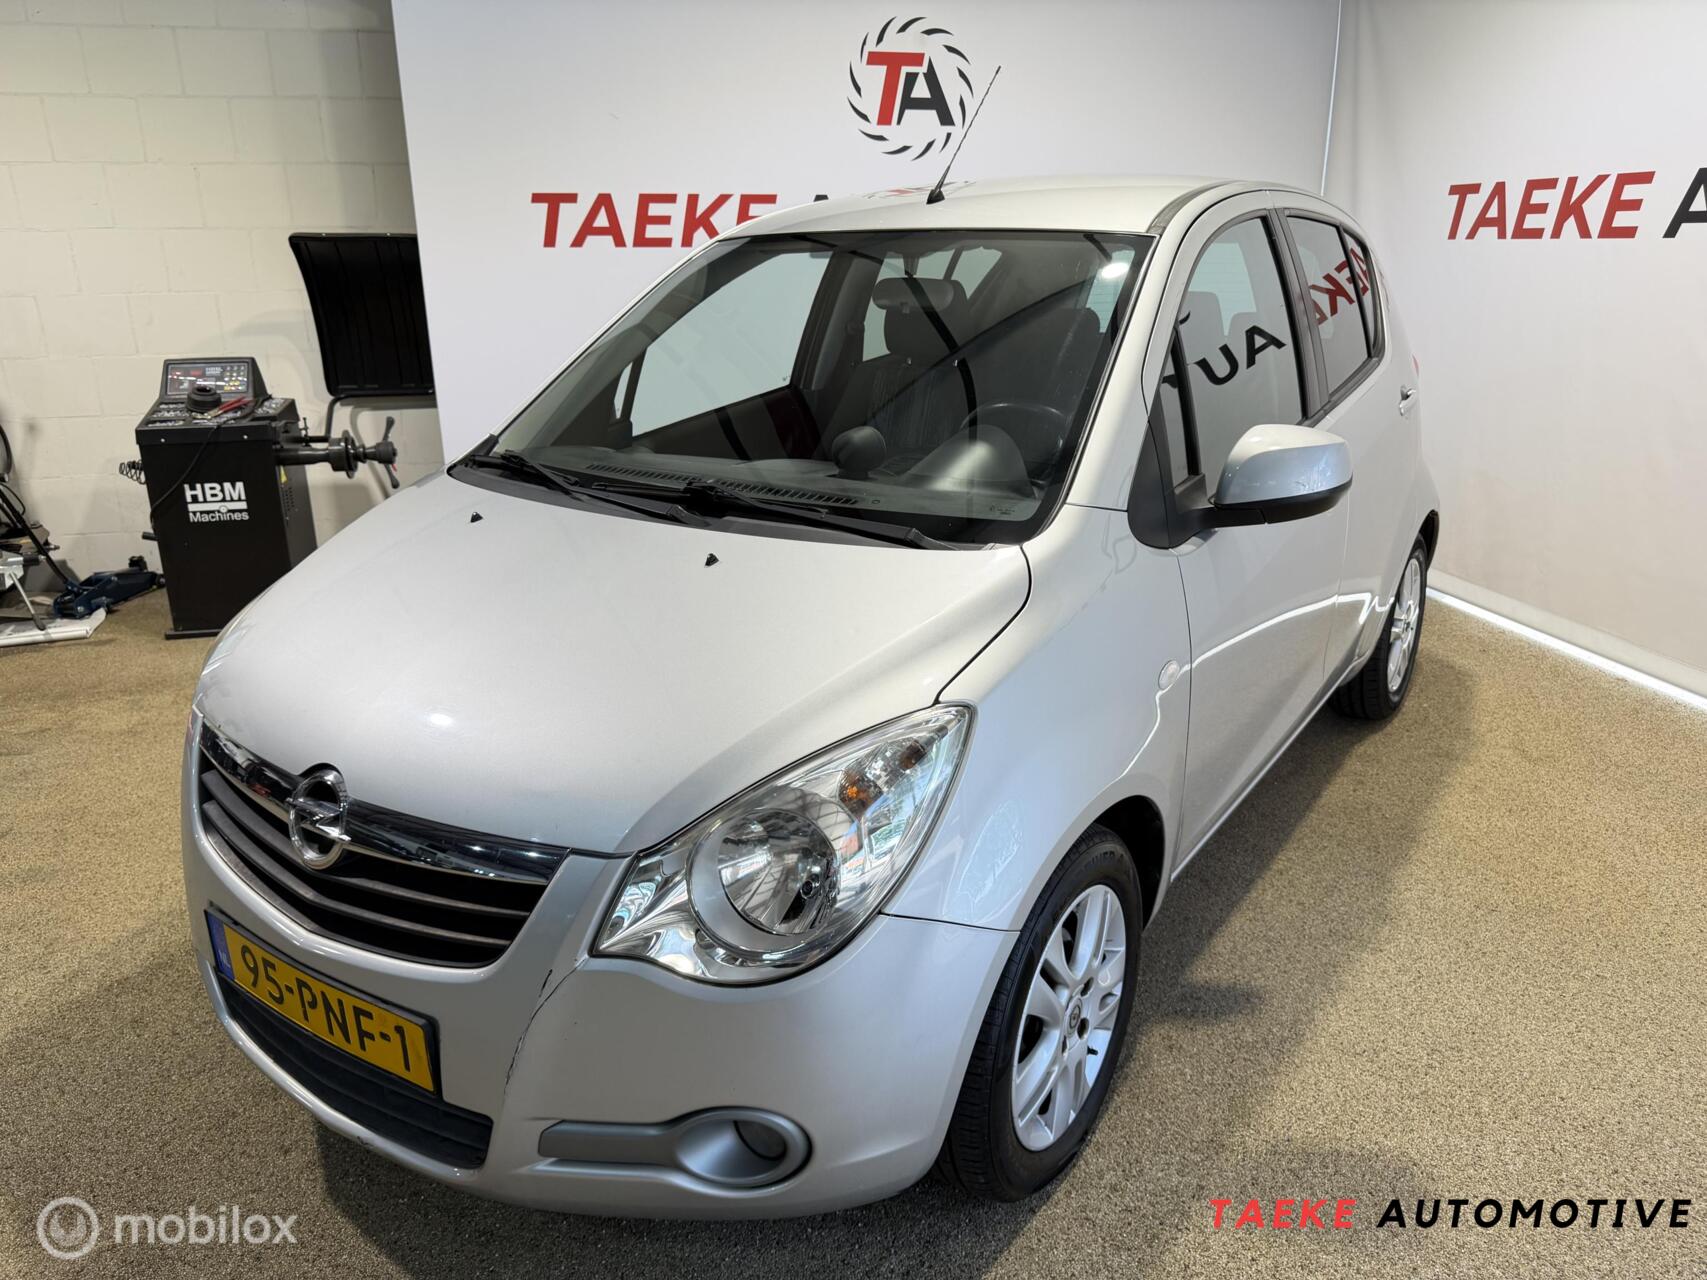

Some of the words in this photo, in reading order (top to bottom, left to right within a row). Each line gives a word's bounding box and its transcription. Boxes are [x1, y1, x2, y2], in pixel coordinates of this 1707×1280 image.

[866, 51, 956, 127] TA
[1447, 170, 1656, 240] TAEKE
[184, 481, 247, 503] HBM
[189, 511, 250, 523] Machines
[240, 944, 412, 1072] 95-PNF-1
